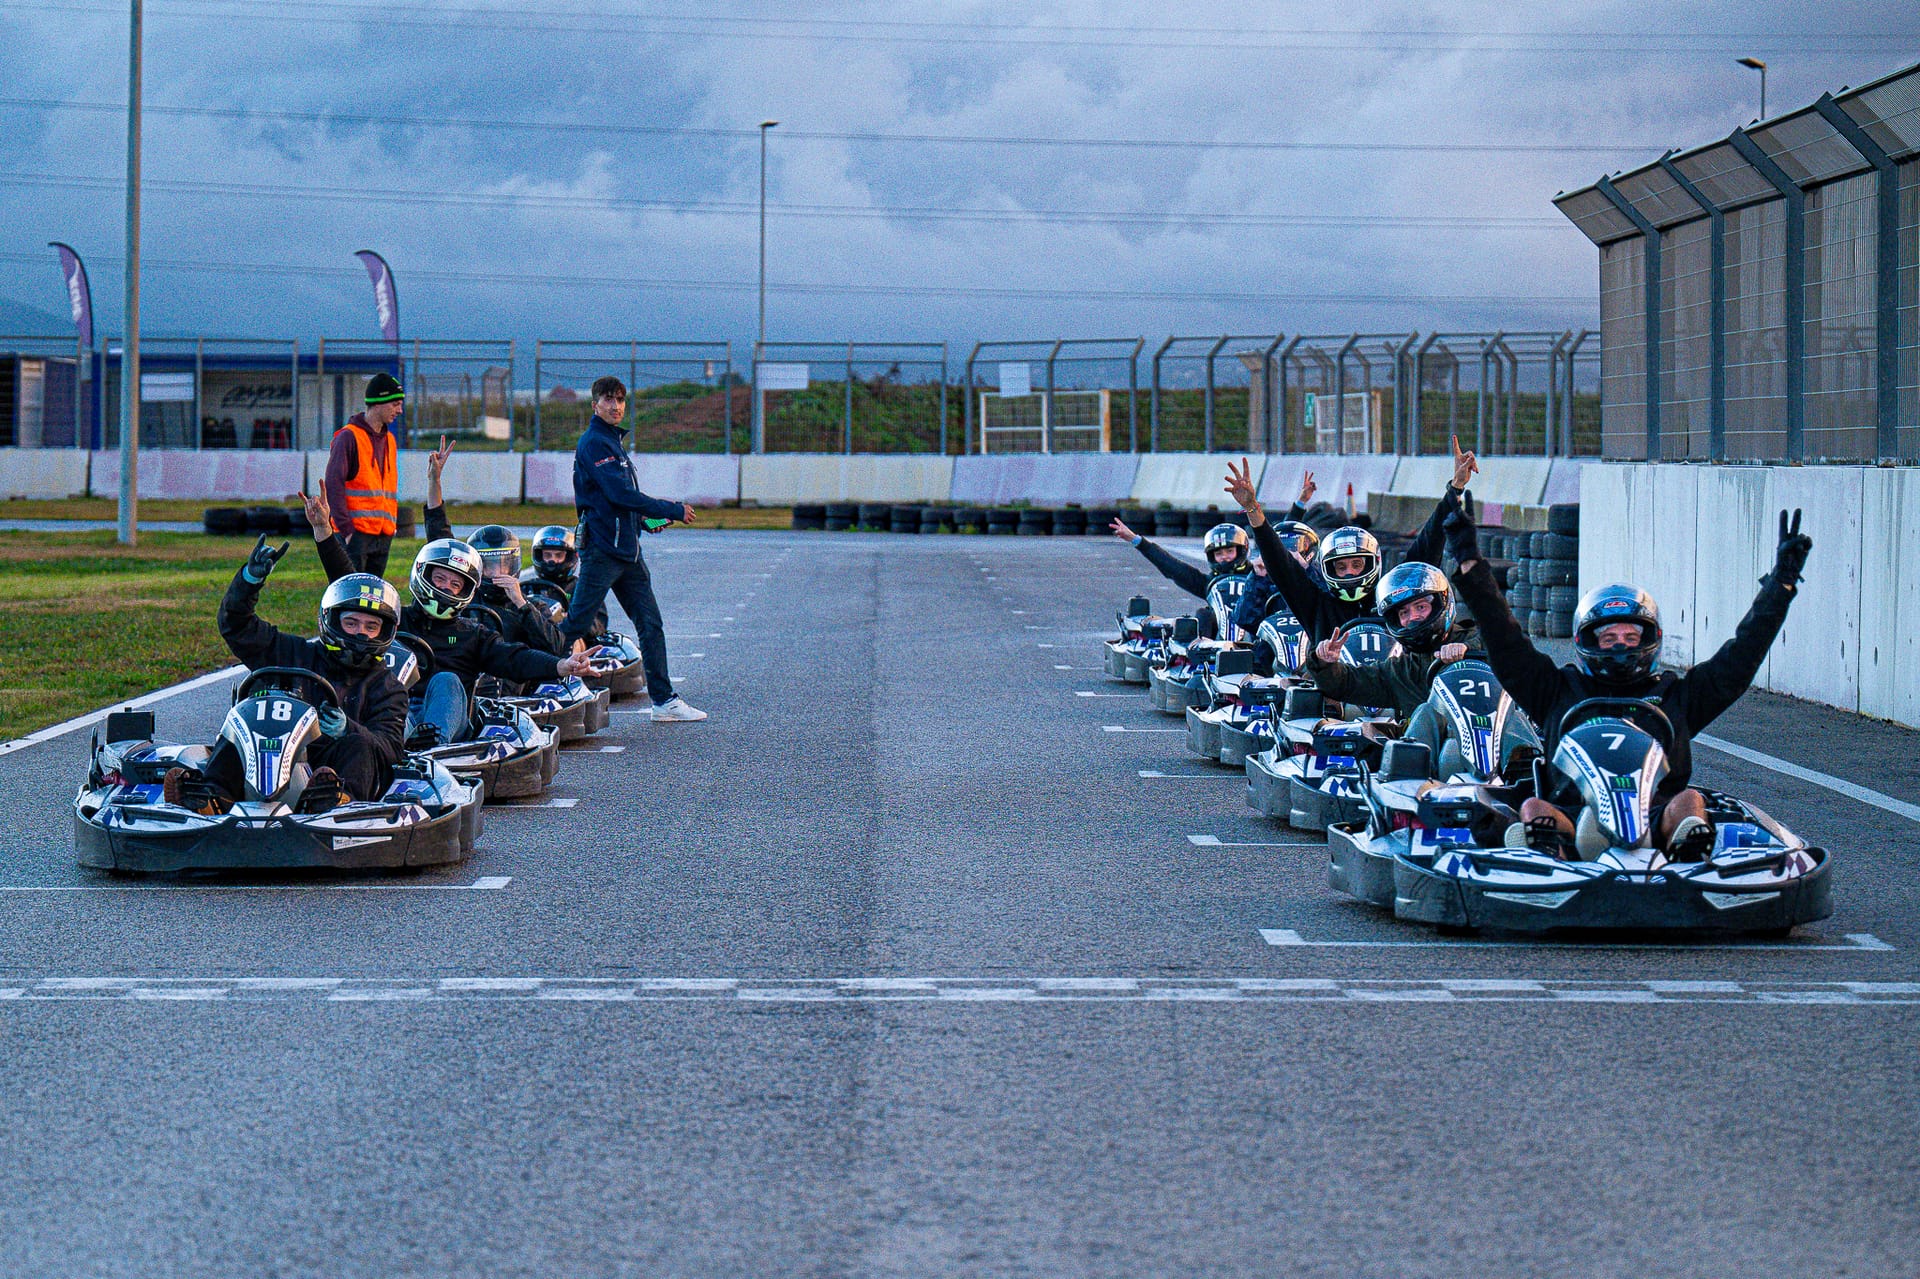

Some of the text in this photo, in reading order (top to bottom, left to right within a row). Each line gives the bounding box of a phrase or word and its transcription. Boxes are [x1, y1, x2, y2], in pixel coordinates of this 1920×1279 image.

[1276, 616, 1300, 627] 28
[1359, 633, 1381, 652] 11
[1458, 679, 1492, 698] 21
[255, 699, 293, 721] 18
[1600, 732, 1627, 750] 7
